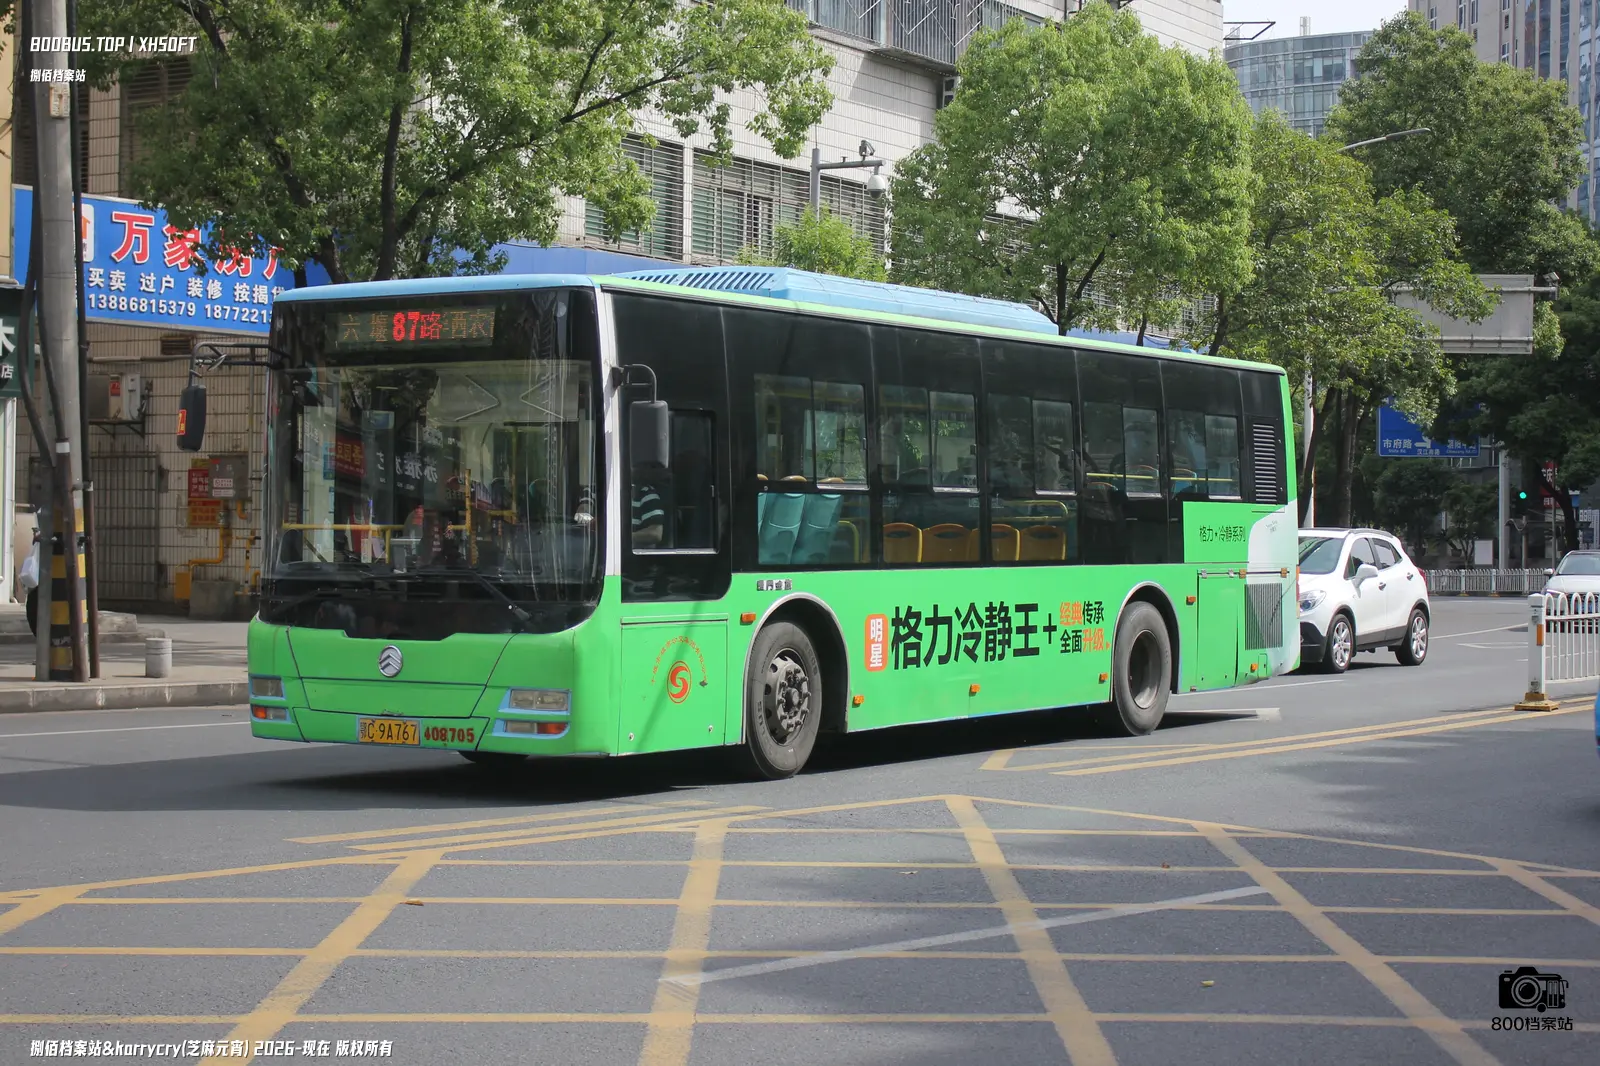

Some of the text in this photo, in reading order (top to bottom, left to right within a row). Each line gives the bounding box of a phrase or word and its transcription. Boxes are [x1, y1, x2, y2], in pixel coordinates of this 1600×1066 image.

[88, 267, 126, 292] 买卖
[139, 271, 175, 295] 过户
[187, 277, 223, 300] 装修
[88, 293, 196, 317] 13886815379
[393, 310, 443, 342] 87路
[1382, 438, 1412, 449] 市府路
[1060, 600, 1105, 626] 经典传承
[869, 617, 884, 669] 明星
